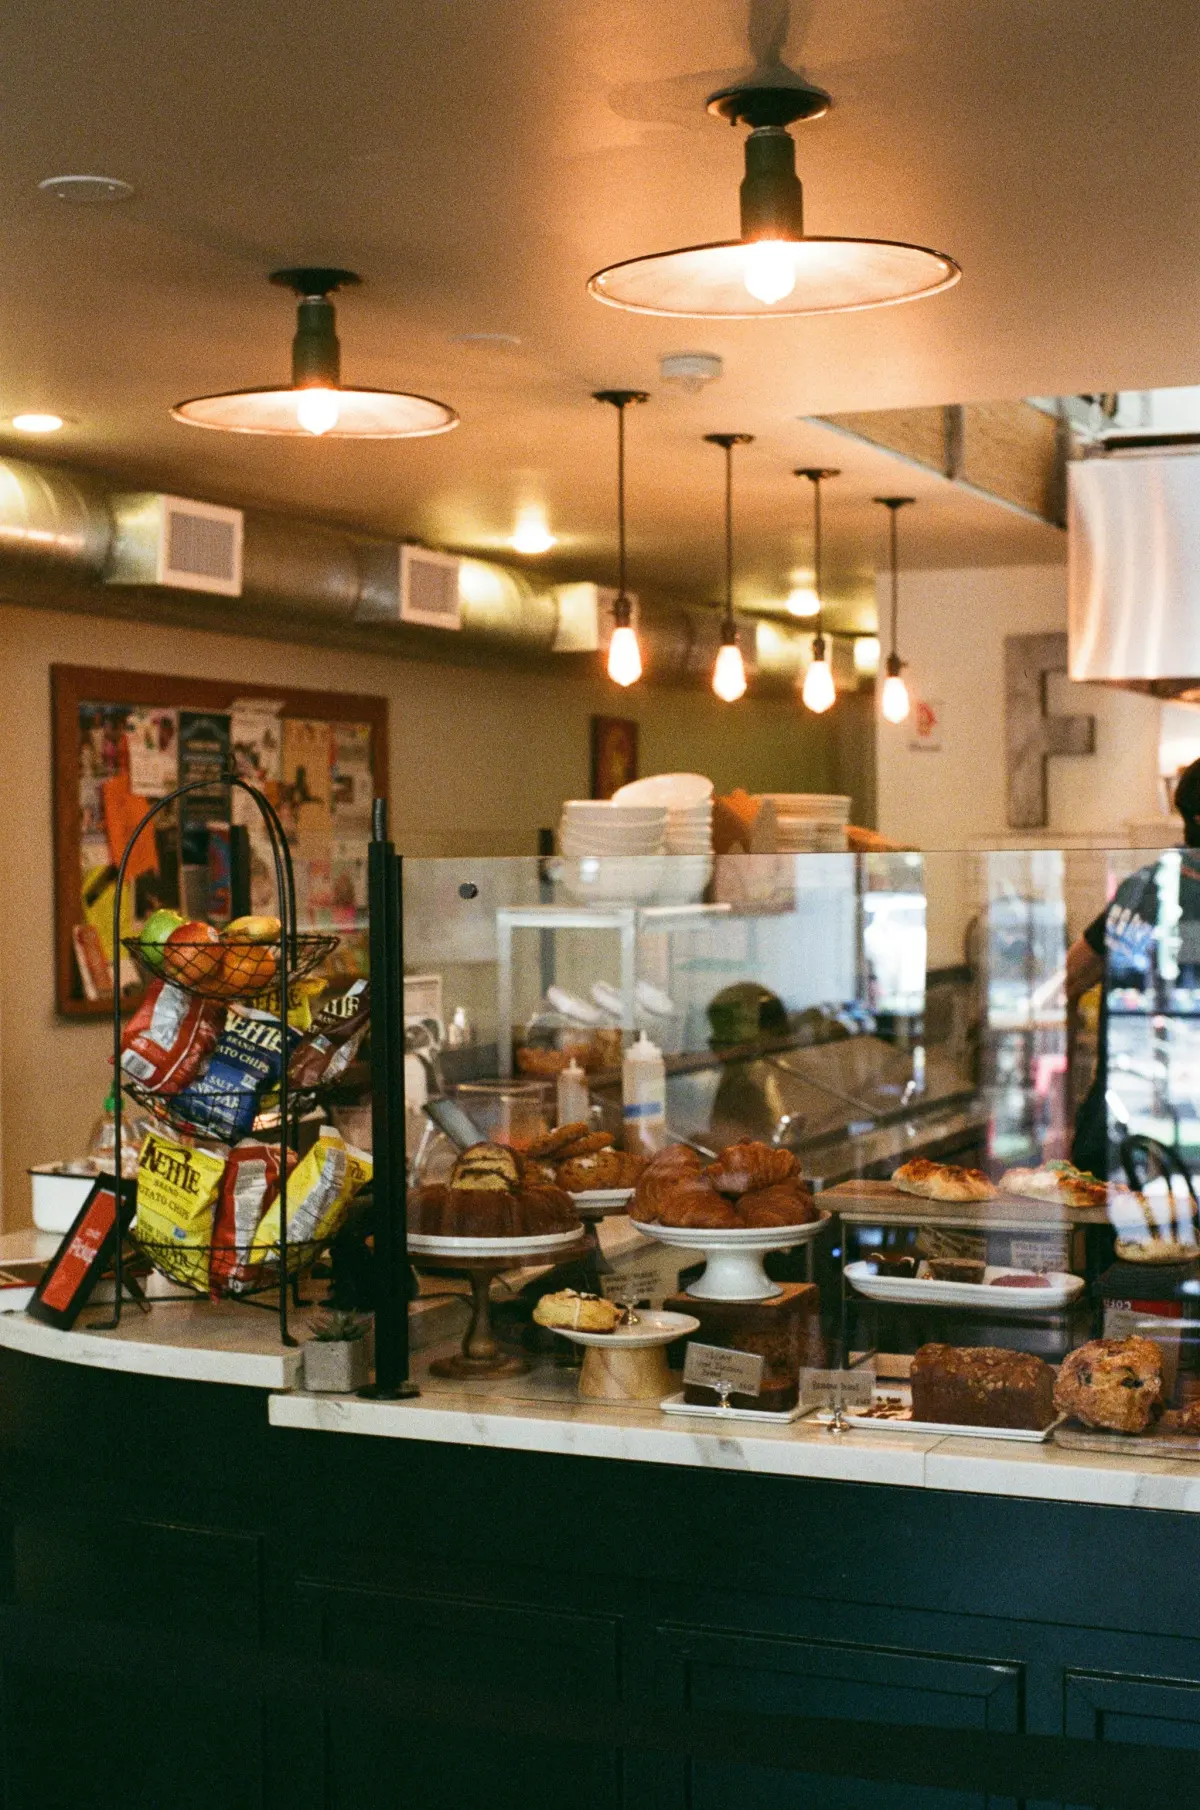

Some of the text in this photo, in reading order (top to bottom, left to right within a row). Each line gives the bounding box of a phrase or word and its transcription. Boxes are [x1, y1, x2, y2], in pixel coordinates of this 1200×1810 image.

[225, 1035, 255, 1052] BRAND
[239, 1054, 270, 1074] CHIPS
[139, 1137, 201, 1196] KETTLE
